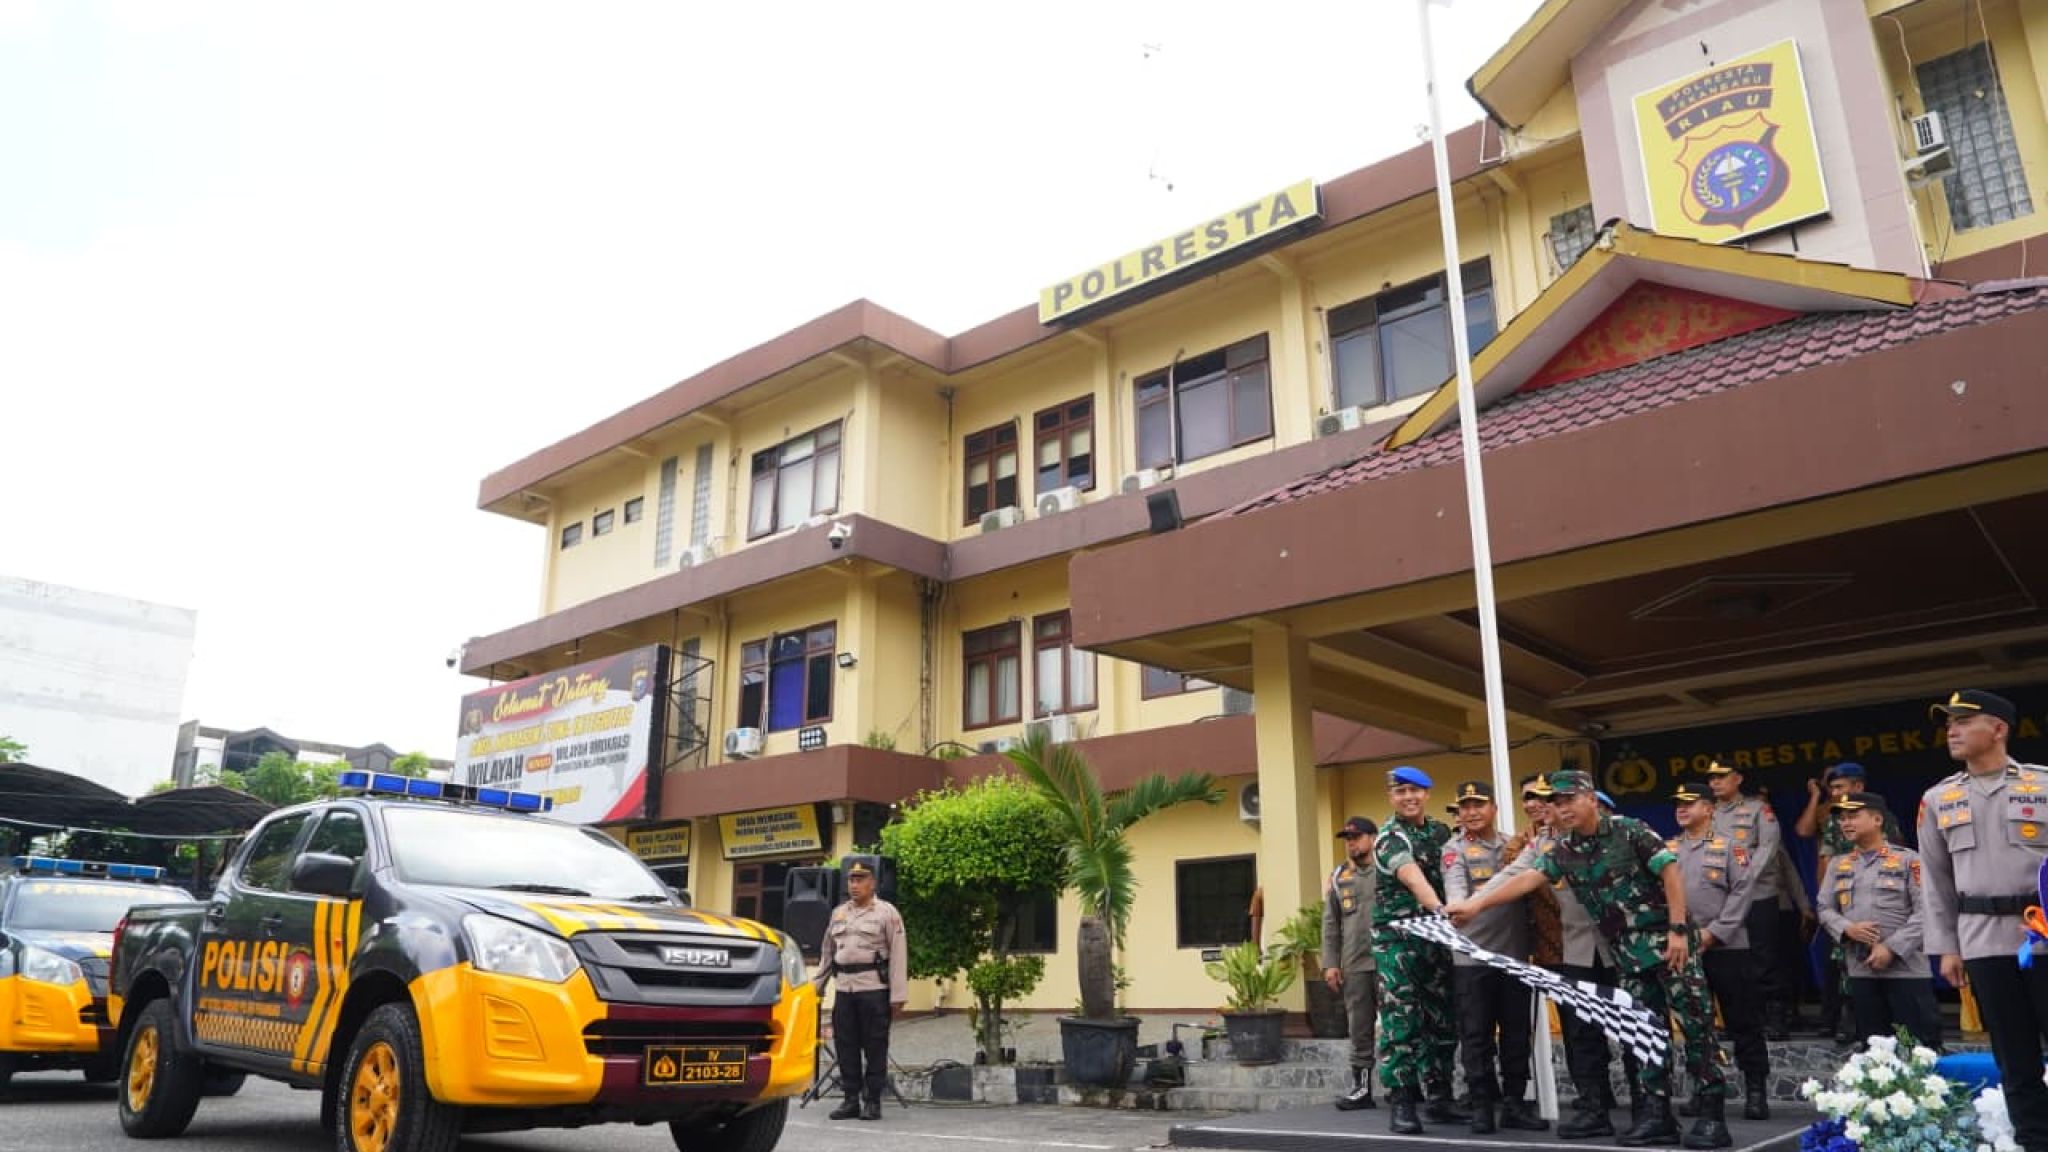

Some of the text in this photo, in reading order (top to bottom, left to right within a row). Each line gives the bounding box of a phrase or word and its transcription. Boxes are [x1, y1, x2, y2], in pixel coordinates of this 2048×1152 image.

[1669, 75, 1761, 113] PEKANBARU
[1672, 66, 1754, 102] POLRESTA
[1678, 93, 1761, 131] RIAU
[1052, 191, 1298, 312] POLRESTA
[493, 673, 610, 722] Selamat Datang
[468, 755, 524, 786] WILAYAH
[1667, 740, 1843, 777] PORESTA
[200, 940, 288, 993] POLISI
[663, 948, 729, 966] ISUZU
[686, 1066, 741, 1080] 2103-28
